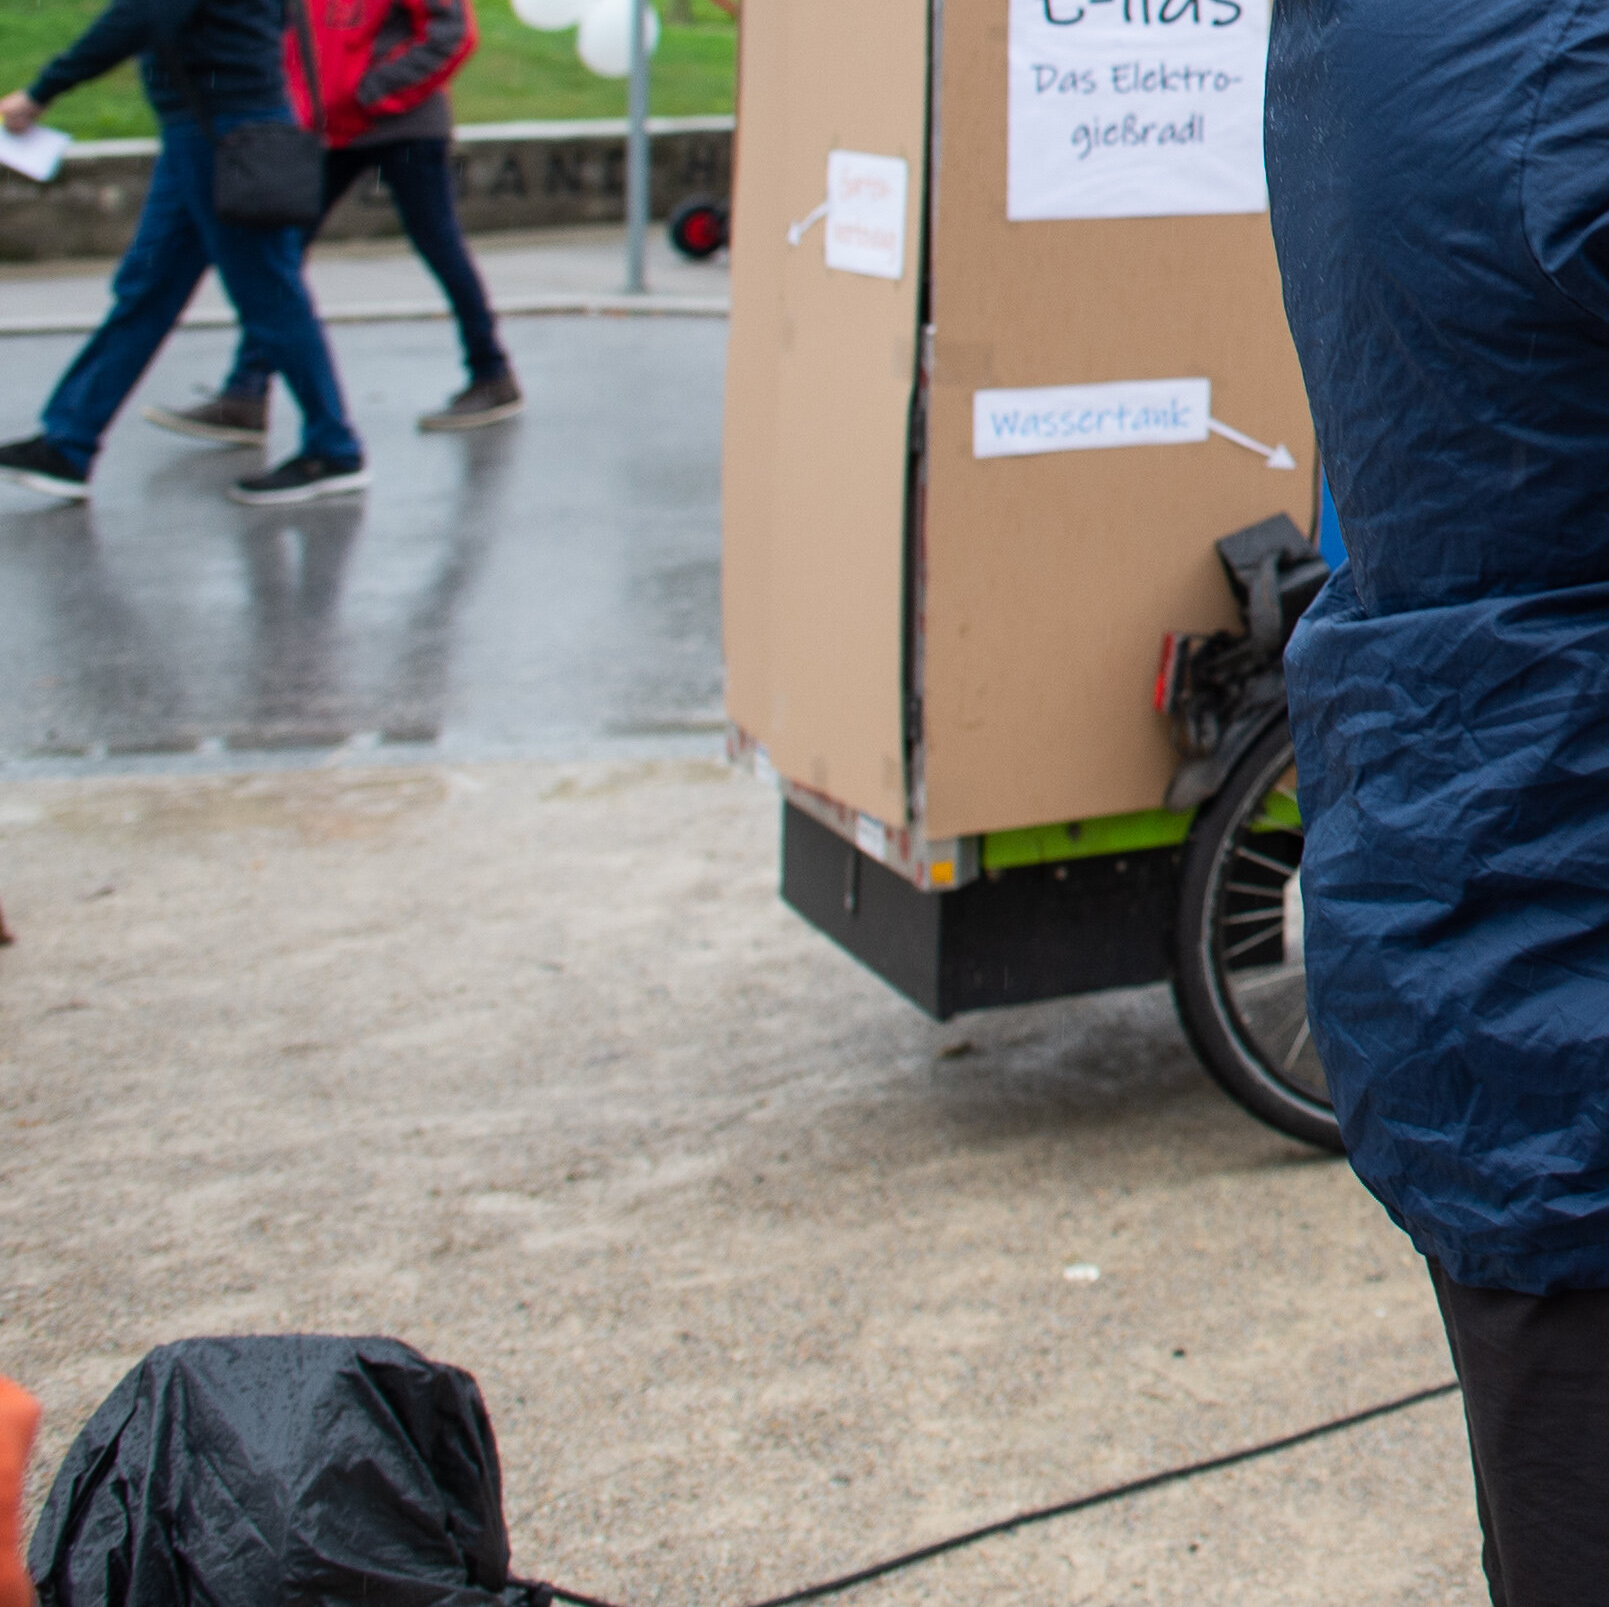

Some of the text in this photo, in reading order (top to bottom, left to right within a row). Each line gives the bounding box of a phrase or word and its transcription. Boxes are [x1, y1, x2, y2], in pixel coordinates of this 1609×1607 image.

[1031, 63, 1243, 95] Das Elektro-
[1070, 113, 1206, 160] gießradl
